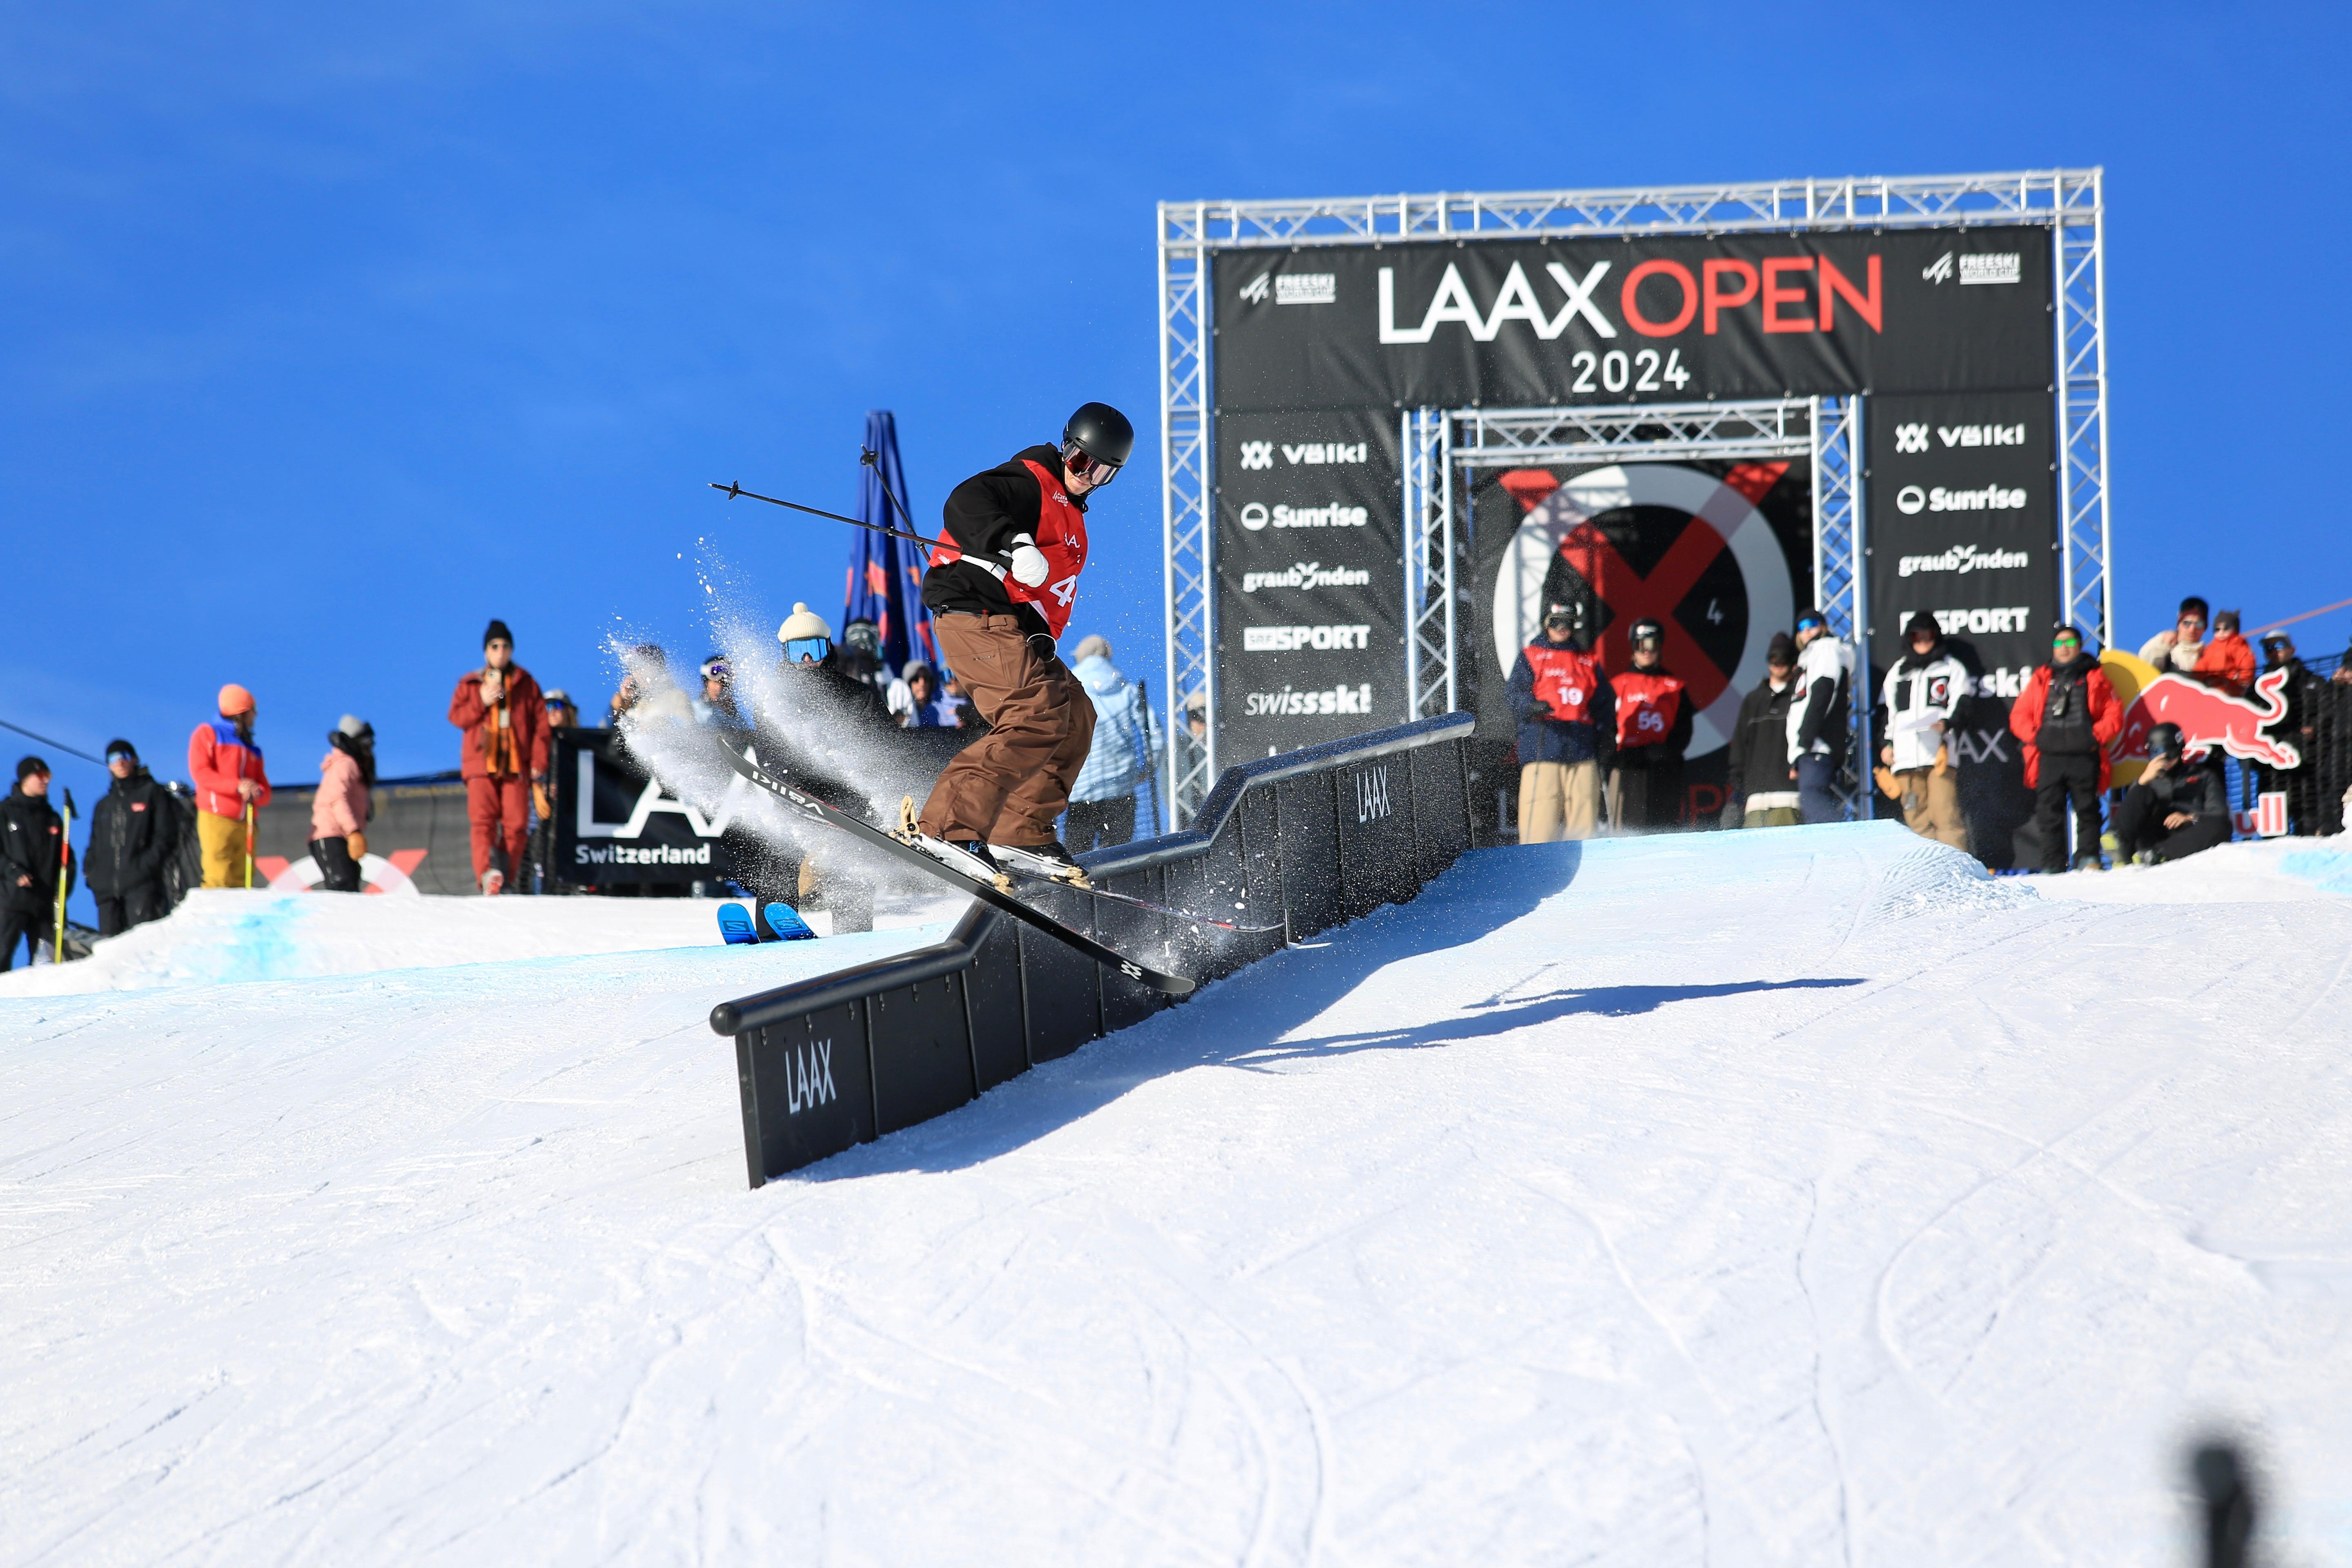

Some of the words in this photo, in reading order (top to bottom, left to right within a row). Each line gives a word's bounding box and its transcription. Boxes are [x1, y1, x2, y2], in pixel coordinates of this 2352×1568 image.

[1959, 252, 2020, 269] FREESKI
[1960, 269, 1996, 278] WORLD
[1275, 273, 1335, 288] FREESKI
[1378, 261, 1617, 344] LAAX
[1621, 254, 1882, 338] OPEN
[1572, 349, 1690, 393] 2024
[1929, 484, 2027, 512] Sunrise
[1272, 502, 1368, 528] Sunrise
[1049, 575, 1078, 608] 4
[1932, 607, 2030, 635] SPORT
[1276, 625, 1371, 650] SPORT
[1245, 683, 1372, 715] swissski
[1557, 686, 1584, 706] 19
[1638, 710, 1664, 732] 56
[1356, 765, 1391, 823] LAAX
[576, 843, 711, 864] Switzerland
[785, 1038, 836, 1114] LAAX
